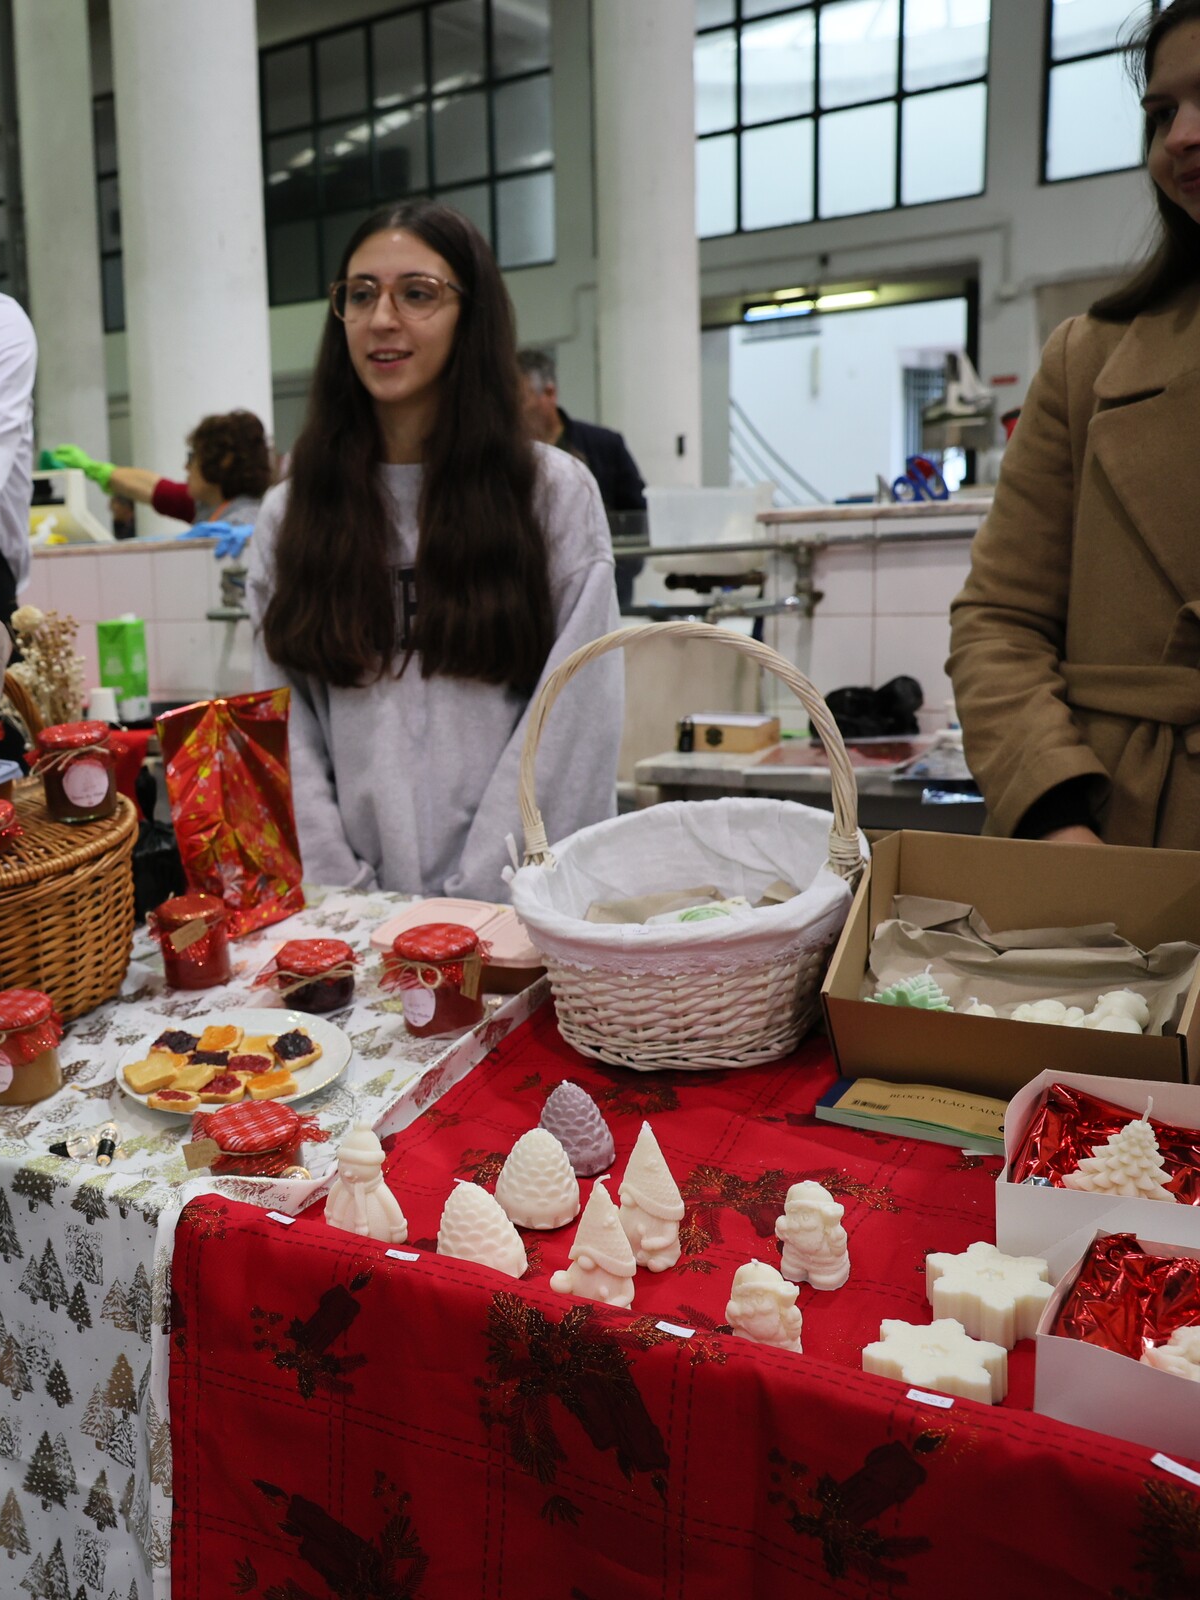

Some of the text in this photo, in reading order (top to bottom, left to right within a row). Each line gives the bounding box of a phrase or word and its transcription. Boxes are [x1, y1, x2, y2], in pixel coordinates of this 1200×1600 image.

[889, 1093, 1004, 1118] BLOCO TALÃO CAIXA
